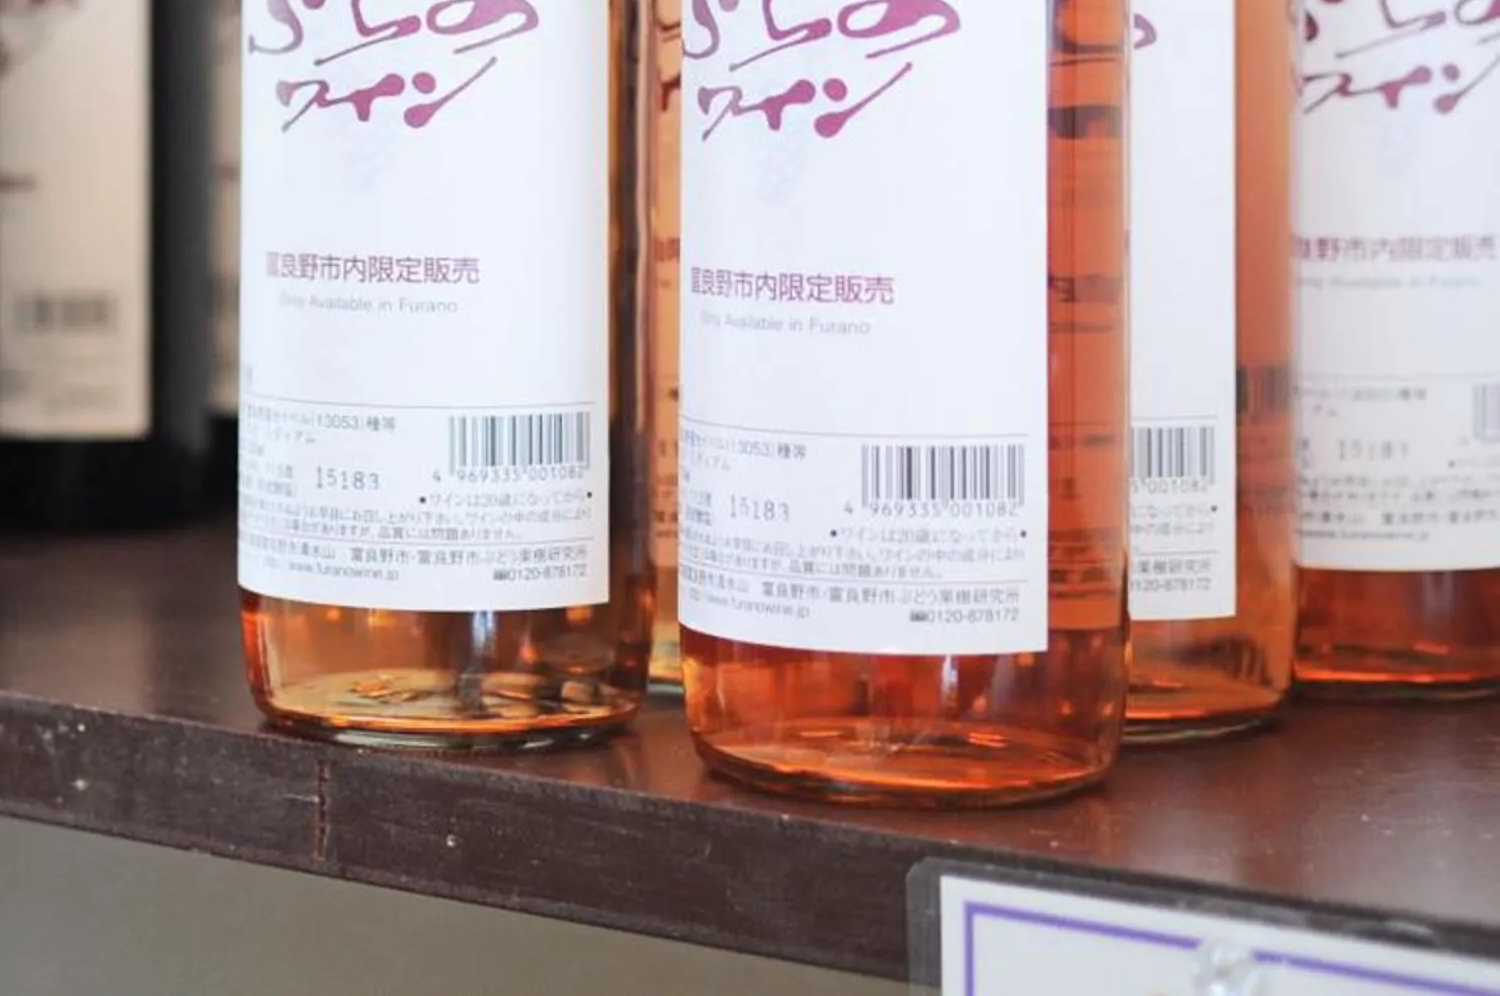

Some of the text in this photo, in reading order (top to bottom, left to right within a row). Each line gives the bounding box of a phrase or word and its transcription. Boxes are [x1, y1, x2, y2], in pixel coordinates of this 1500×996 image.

[788, 312, 803, 332] in
[809, 315, 872, 335] Furano
[315, 464, 381, 491] 15183
[729, 492, 790, 522] 15183
[950, 501, 1019, 517] 001082
